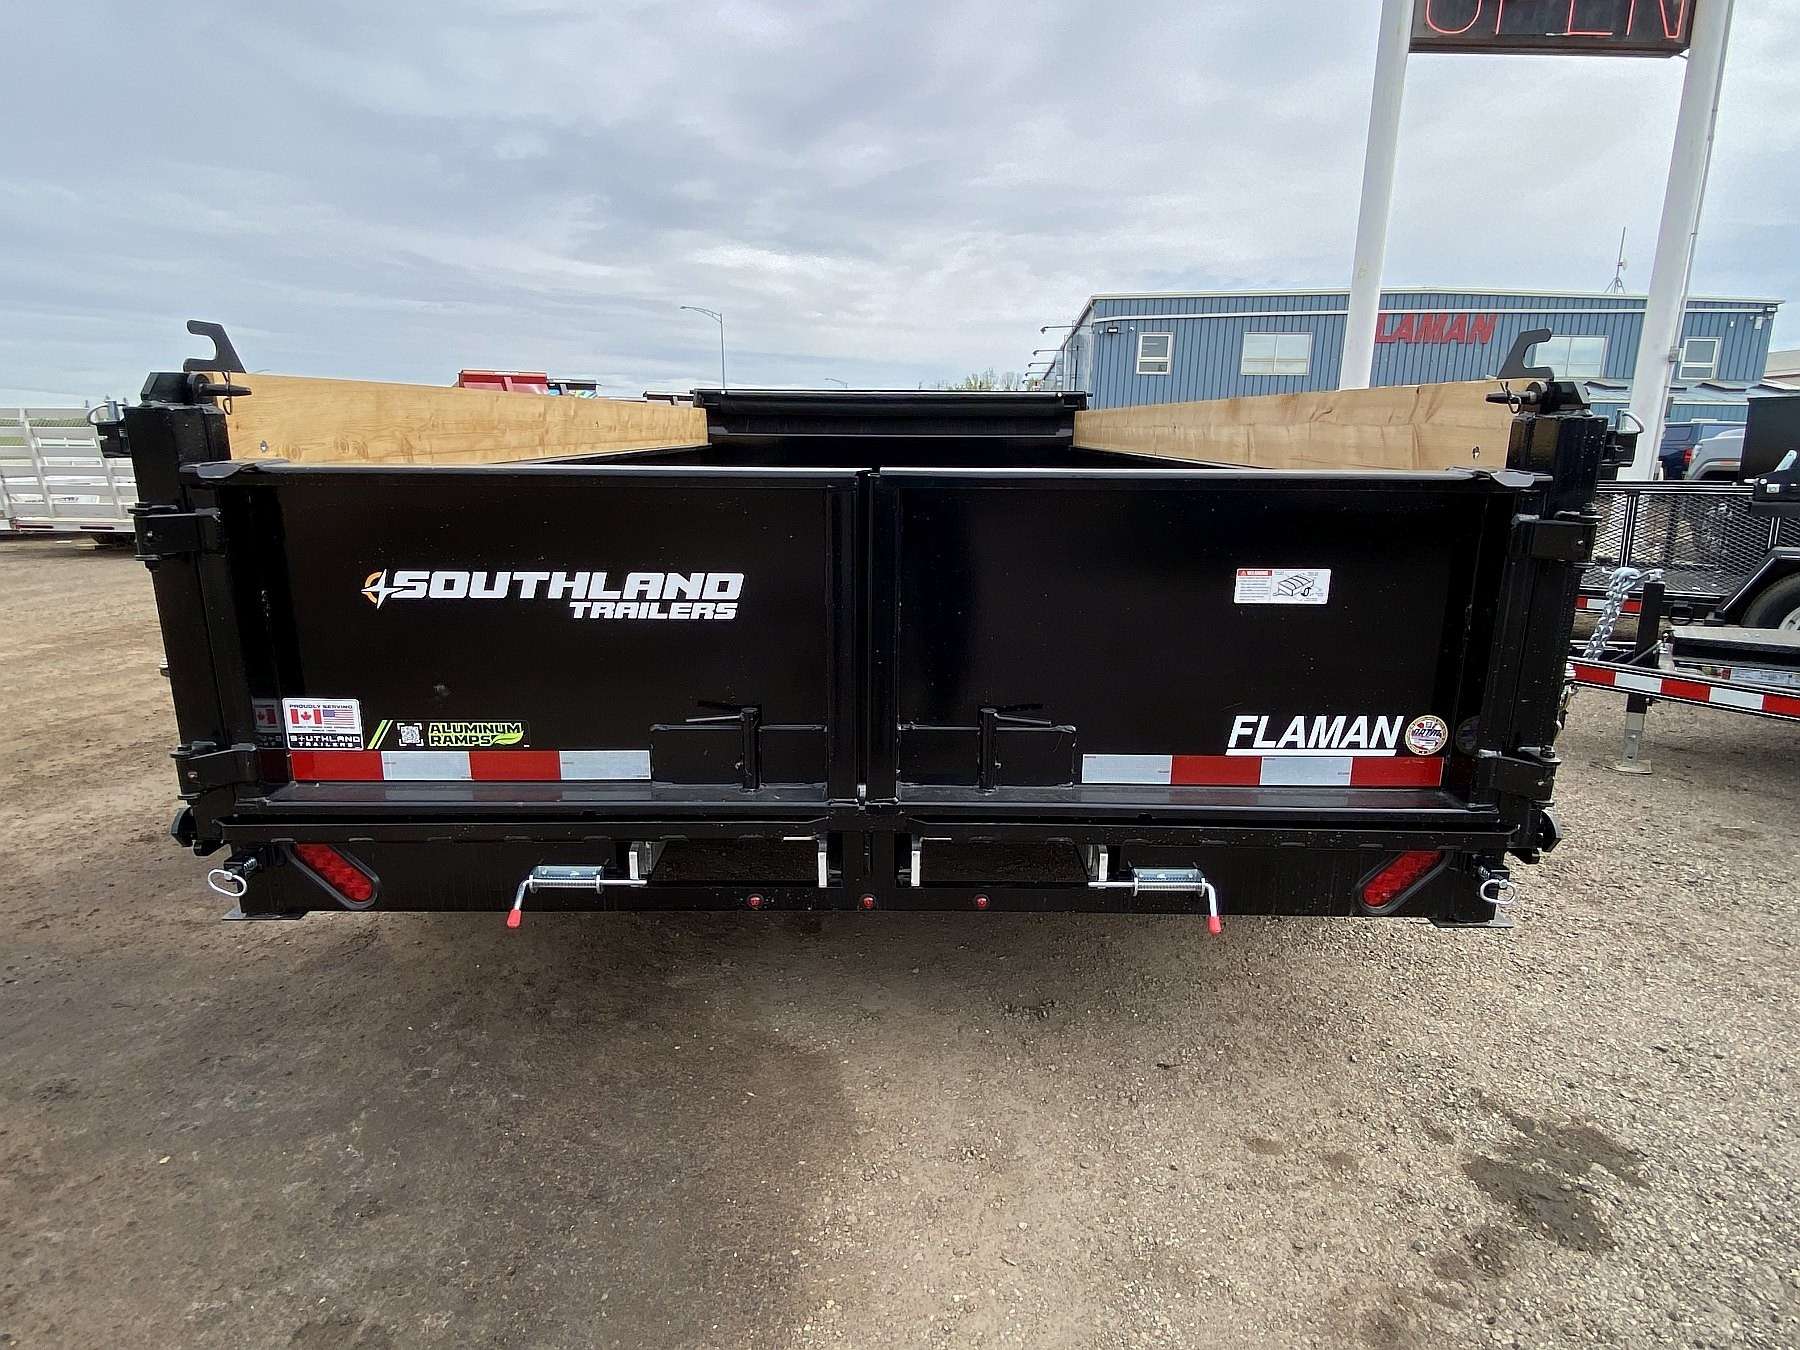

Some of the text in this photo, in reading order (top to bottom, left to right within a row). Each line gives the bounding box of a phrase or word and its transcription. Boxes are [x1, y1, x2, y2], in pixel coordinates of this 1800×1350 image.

[1375, 313, 1498, 344] LAMAN
[391, 571, 745, 599] SOUTHLAND
[569, 601, 738, 620] TRAILERS
[429, 722, 522, 735] ALUMINUM
[1227, 715, 1405, 749] FLAMAN
[429, 734, 493, 747] RAMPS
